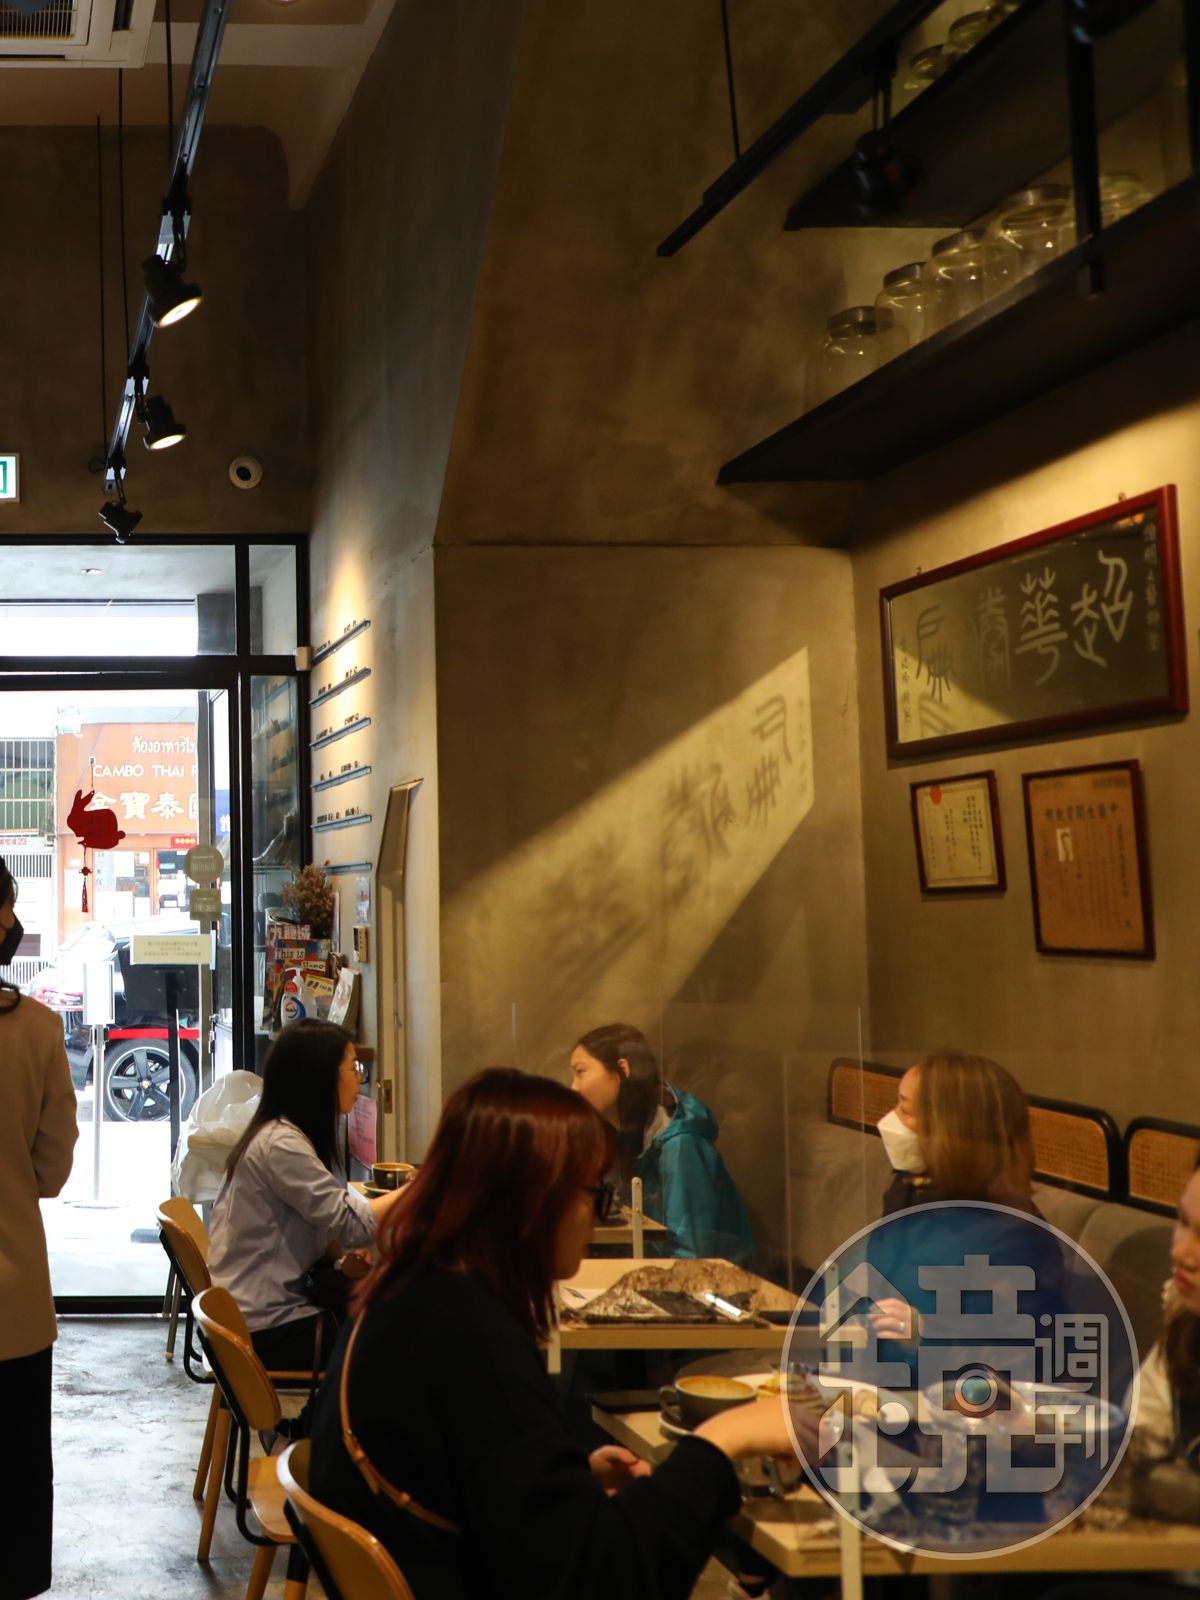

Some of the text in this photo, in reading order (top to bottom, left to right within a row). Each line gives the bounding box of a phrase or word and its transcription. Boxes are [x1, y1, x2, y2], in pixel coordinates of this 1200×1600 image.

[93, 764, 144, 778] CAMBO
[152, 764, 184, 778] THAI
[296, 950, 305, 959] is
